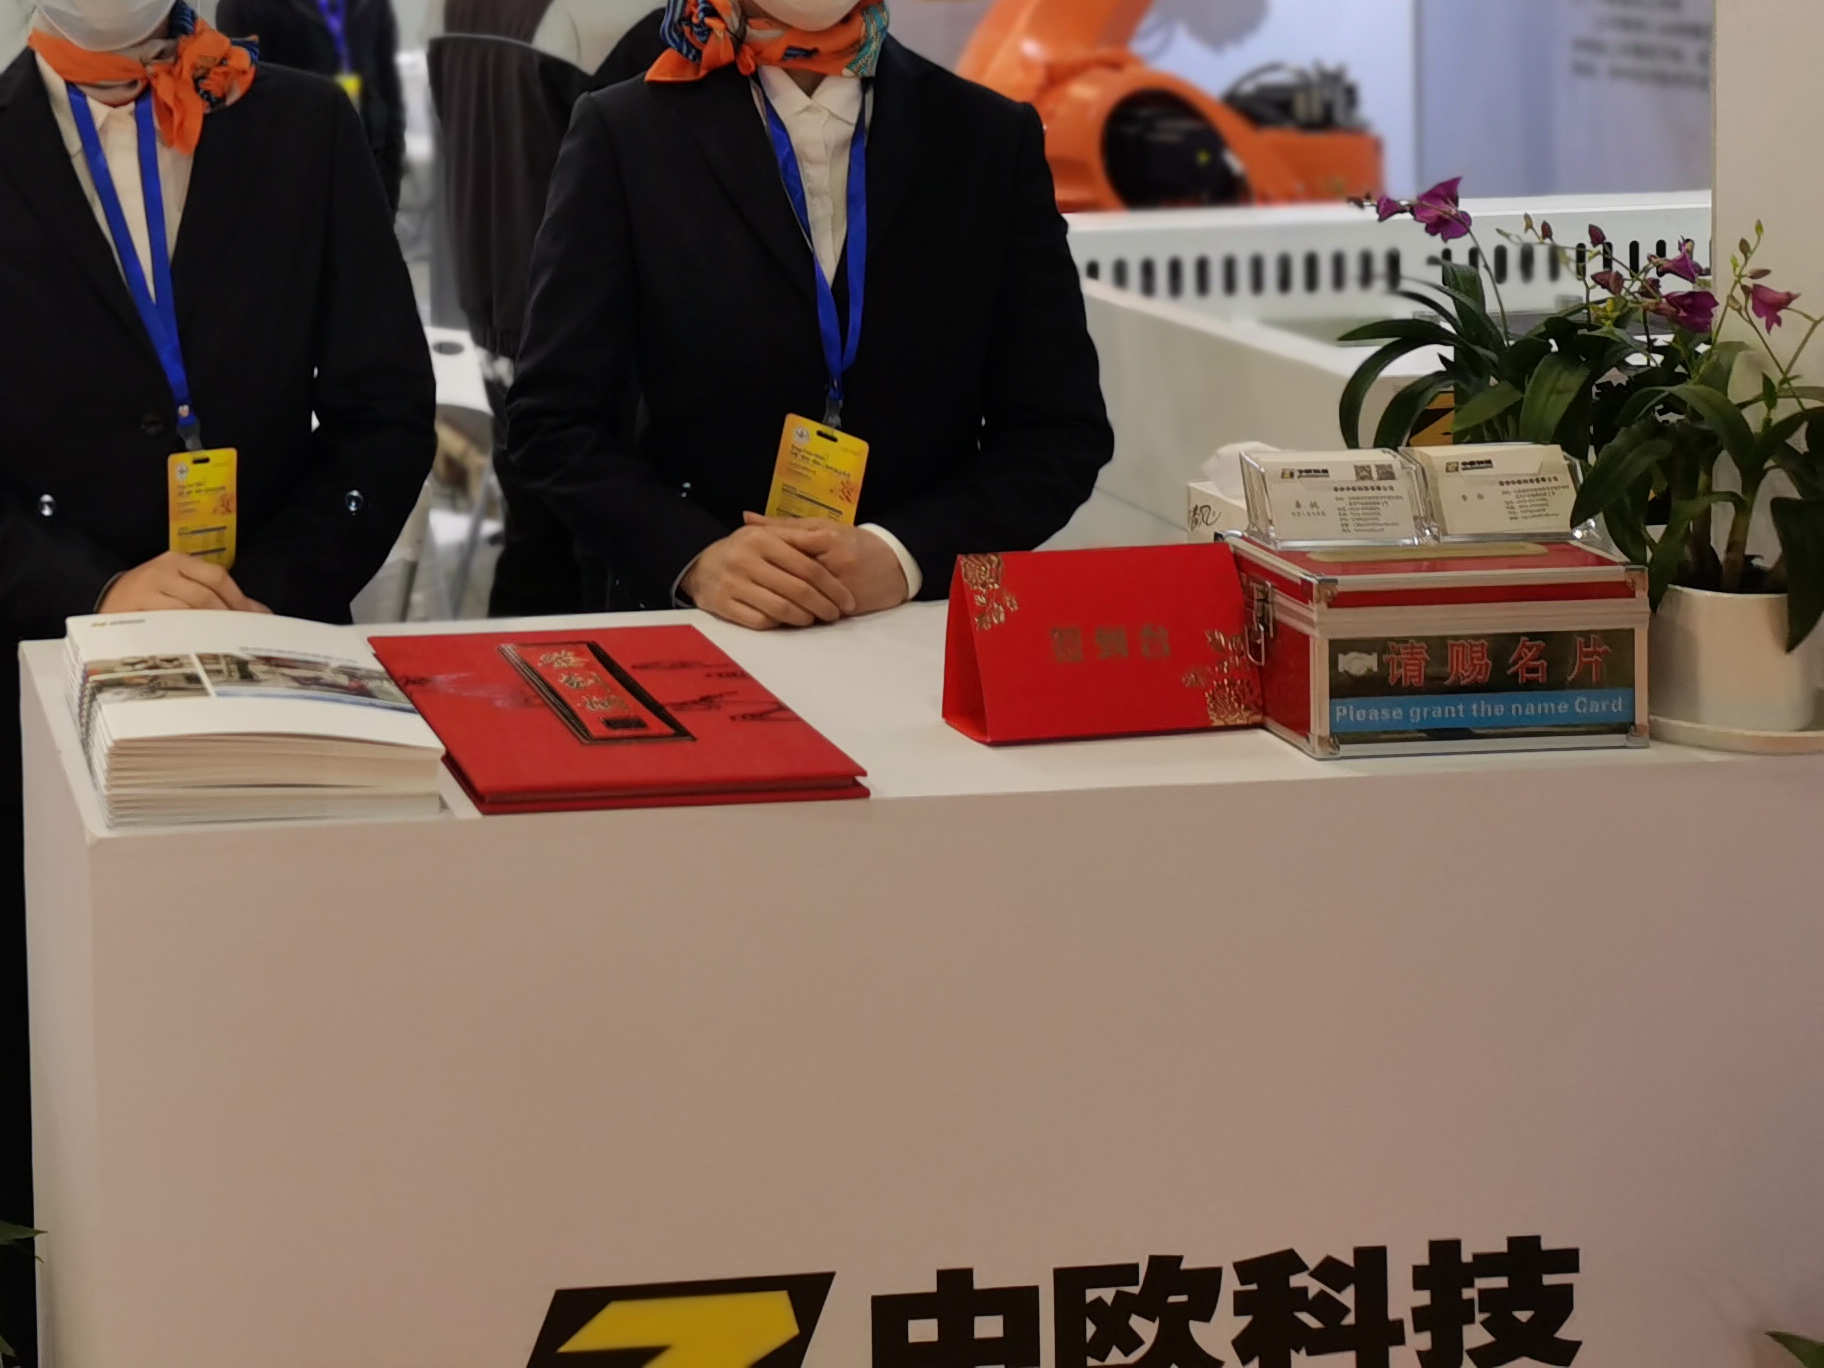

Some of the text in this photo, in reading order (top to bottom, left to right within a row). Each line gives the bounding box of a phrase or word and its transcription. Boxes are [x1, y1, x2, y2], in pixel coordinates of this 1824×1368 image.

[1382, 634, 1612, 687] 请赐名片
[1335, 704, 1404, 723] Please
[1409, 704, 1465, 724] grant
[1471, 699, 1505, 718] the
[1511, 701, 1569, 718] name
[870, 1235, 1583, 1368] 中欧科技
